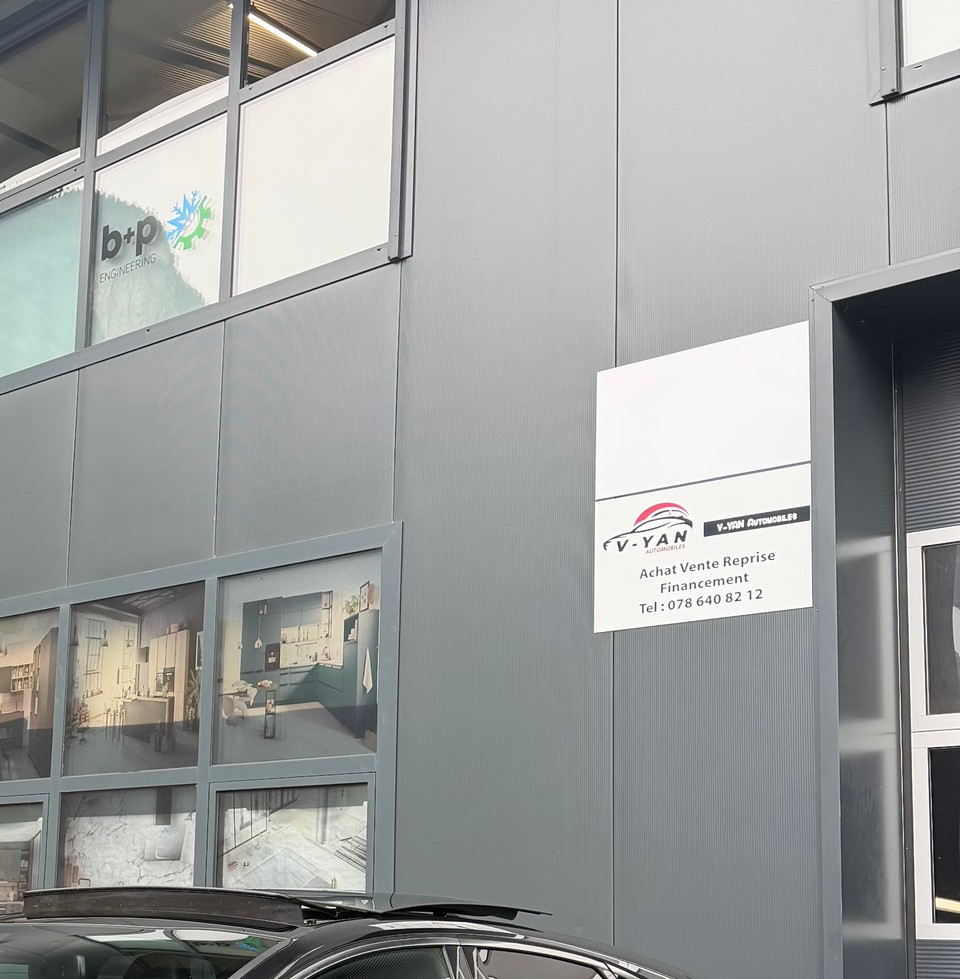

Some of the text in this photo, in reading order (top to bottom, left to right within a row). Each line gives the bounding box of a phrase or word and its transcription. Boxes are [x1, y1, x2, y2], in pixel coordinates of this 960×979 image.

[101, 216, 158, 261] b+p
[99, 253, 157, 283] ENGINEERING
[716, 519, 744, 532] V-YAN
[616, 530, 688, 552] V-YAN
[645, 544, 686, 554] AUTOMOBILES
[639, 551, 776, 579] Achat Vente Reprise
[660, 572, 749, 594] Financement
[667, 598, 693, 610] 078
[696, 594, 721, 607] 640
[725, 591, 742, 603] 82
[747, 588, 763, 600] 12
